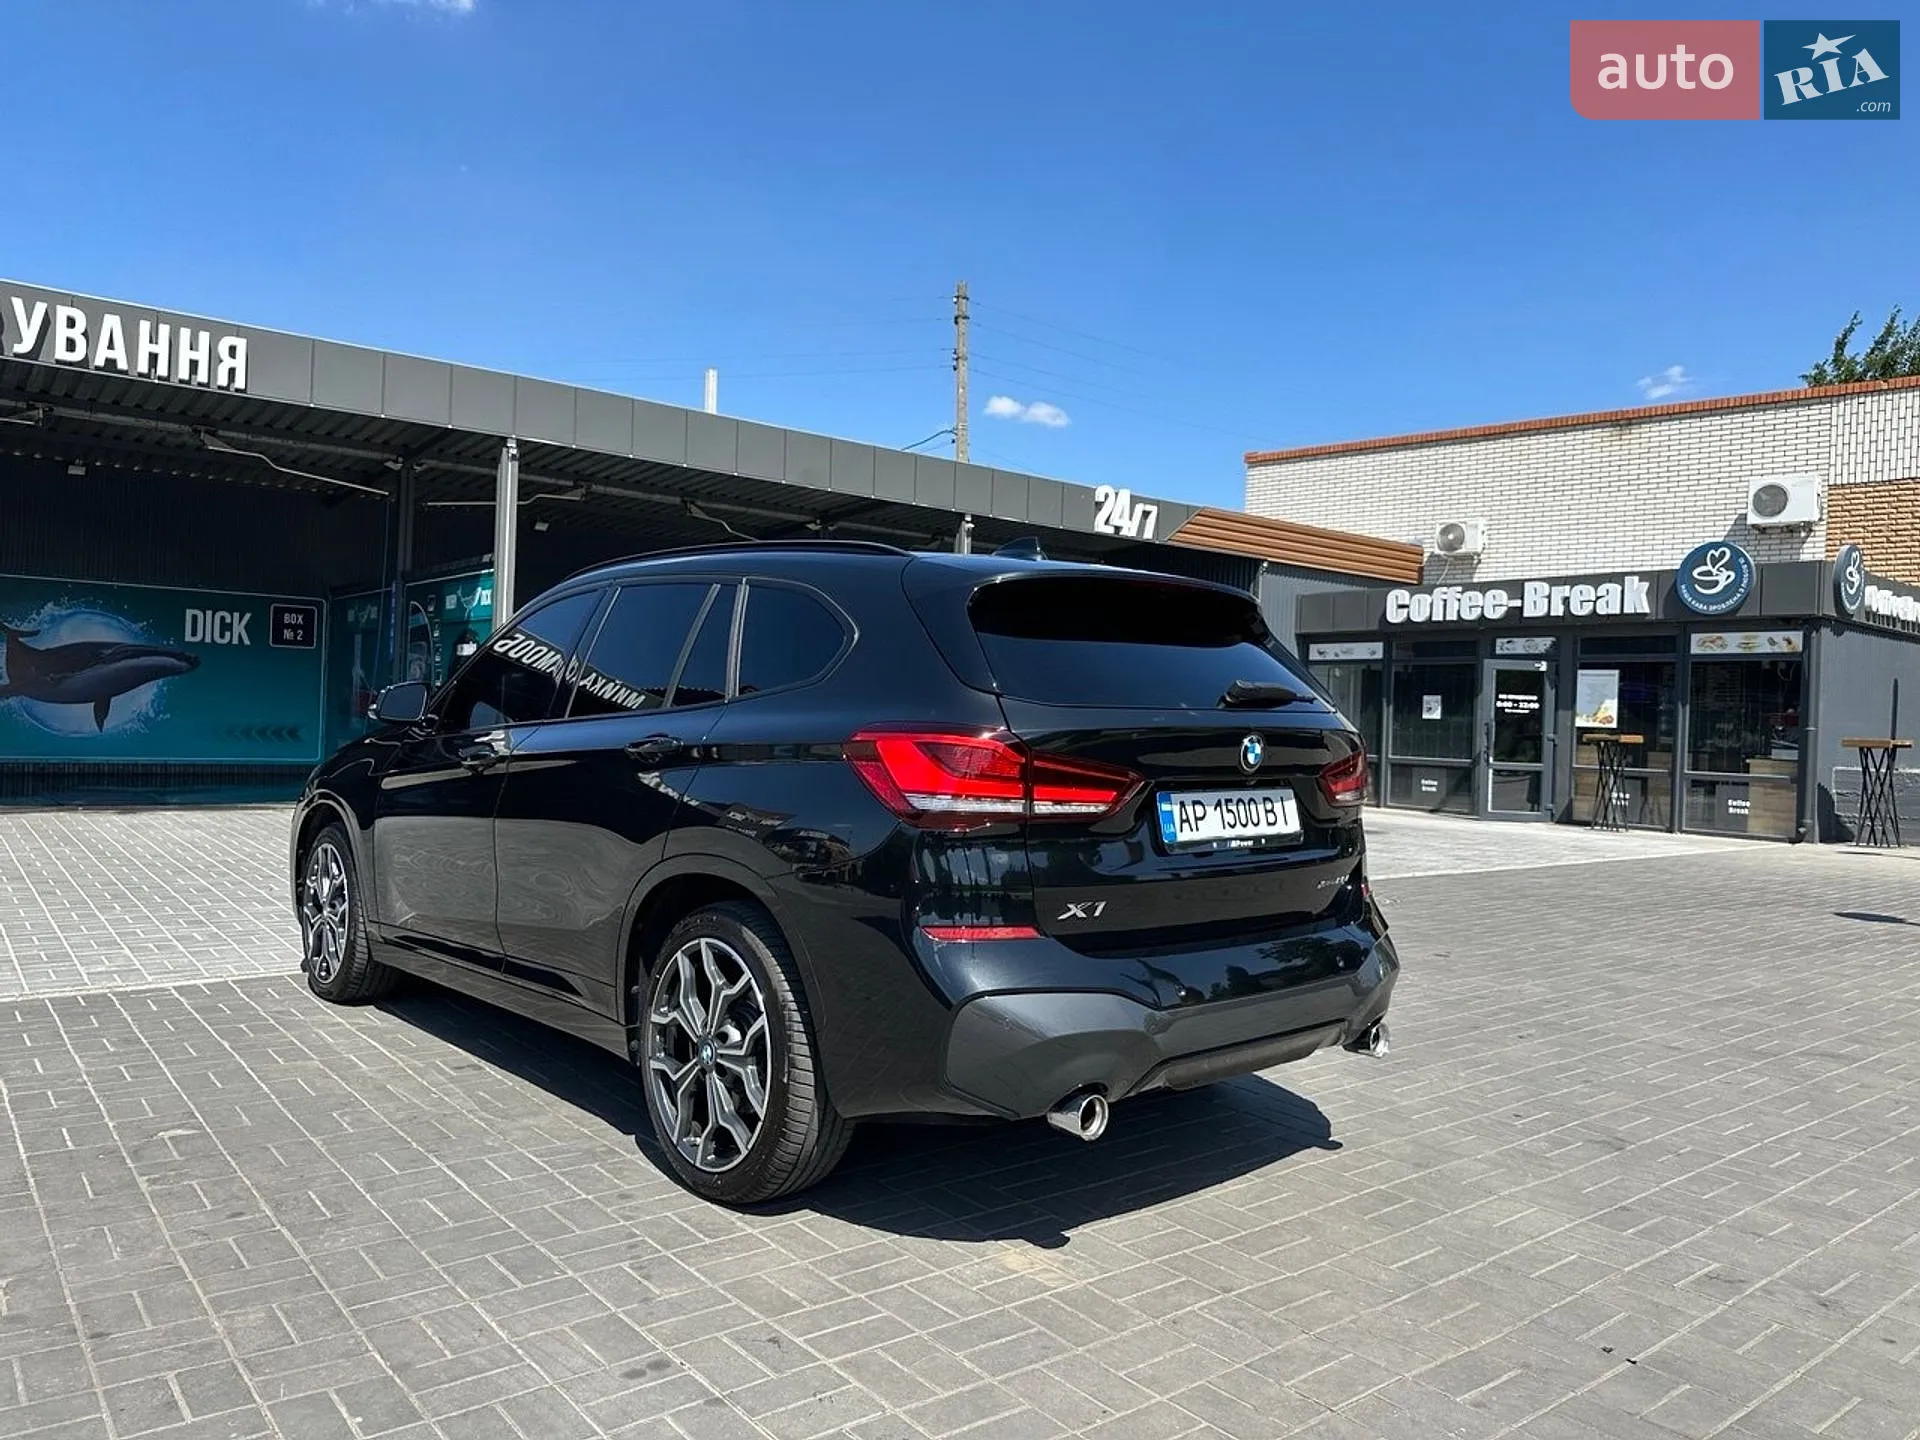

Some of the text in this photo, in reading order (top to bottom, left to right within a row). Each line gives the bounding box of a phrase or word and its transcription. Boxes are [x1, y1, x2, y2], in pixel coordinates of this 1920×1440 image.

[11, 296, 248, 391] УВАННЯ
[1094, 484, 1158, 540] 24/7
[1386, 576, 1650, 624] Coffee-Break
[184, 608, 251, 645] DICK
[284, 613, 304, 625] BOX
[297, 629, 303, 641] 2
[1179, 799, 1207, 833] AP
[1214, 797, 1261, 829] 1500
[1057, 901, 1107, 920] X1
